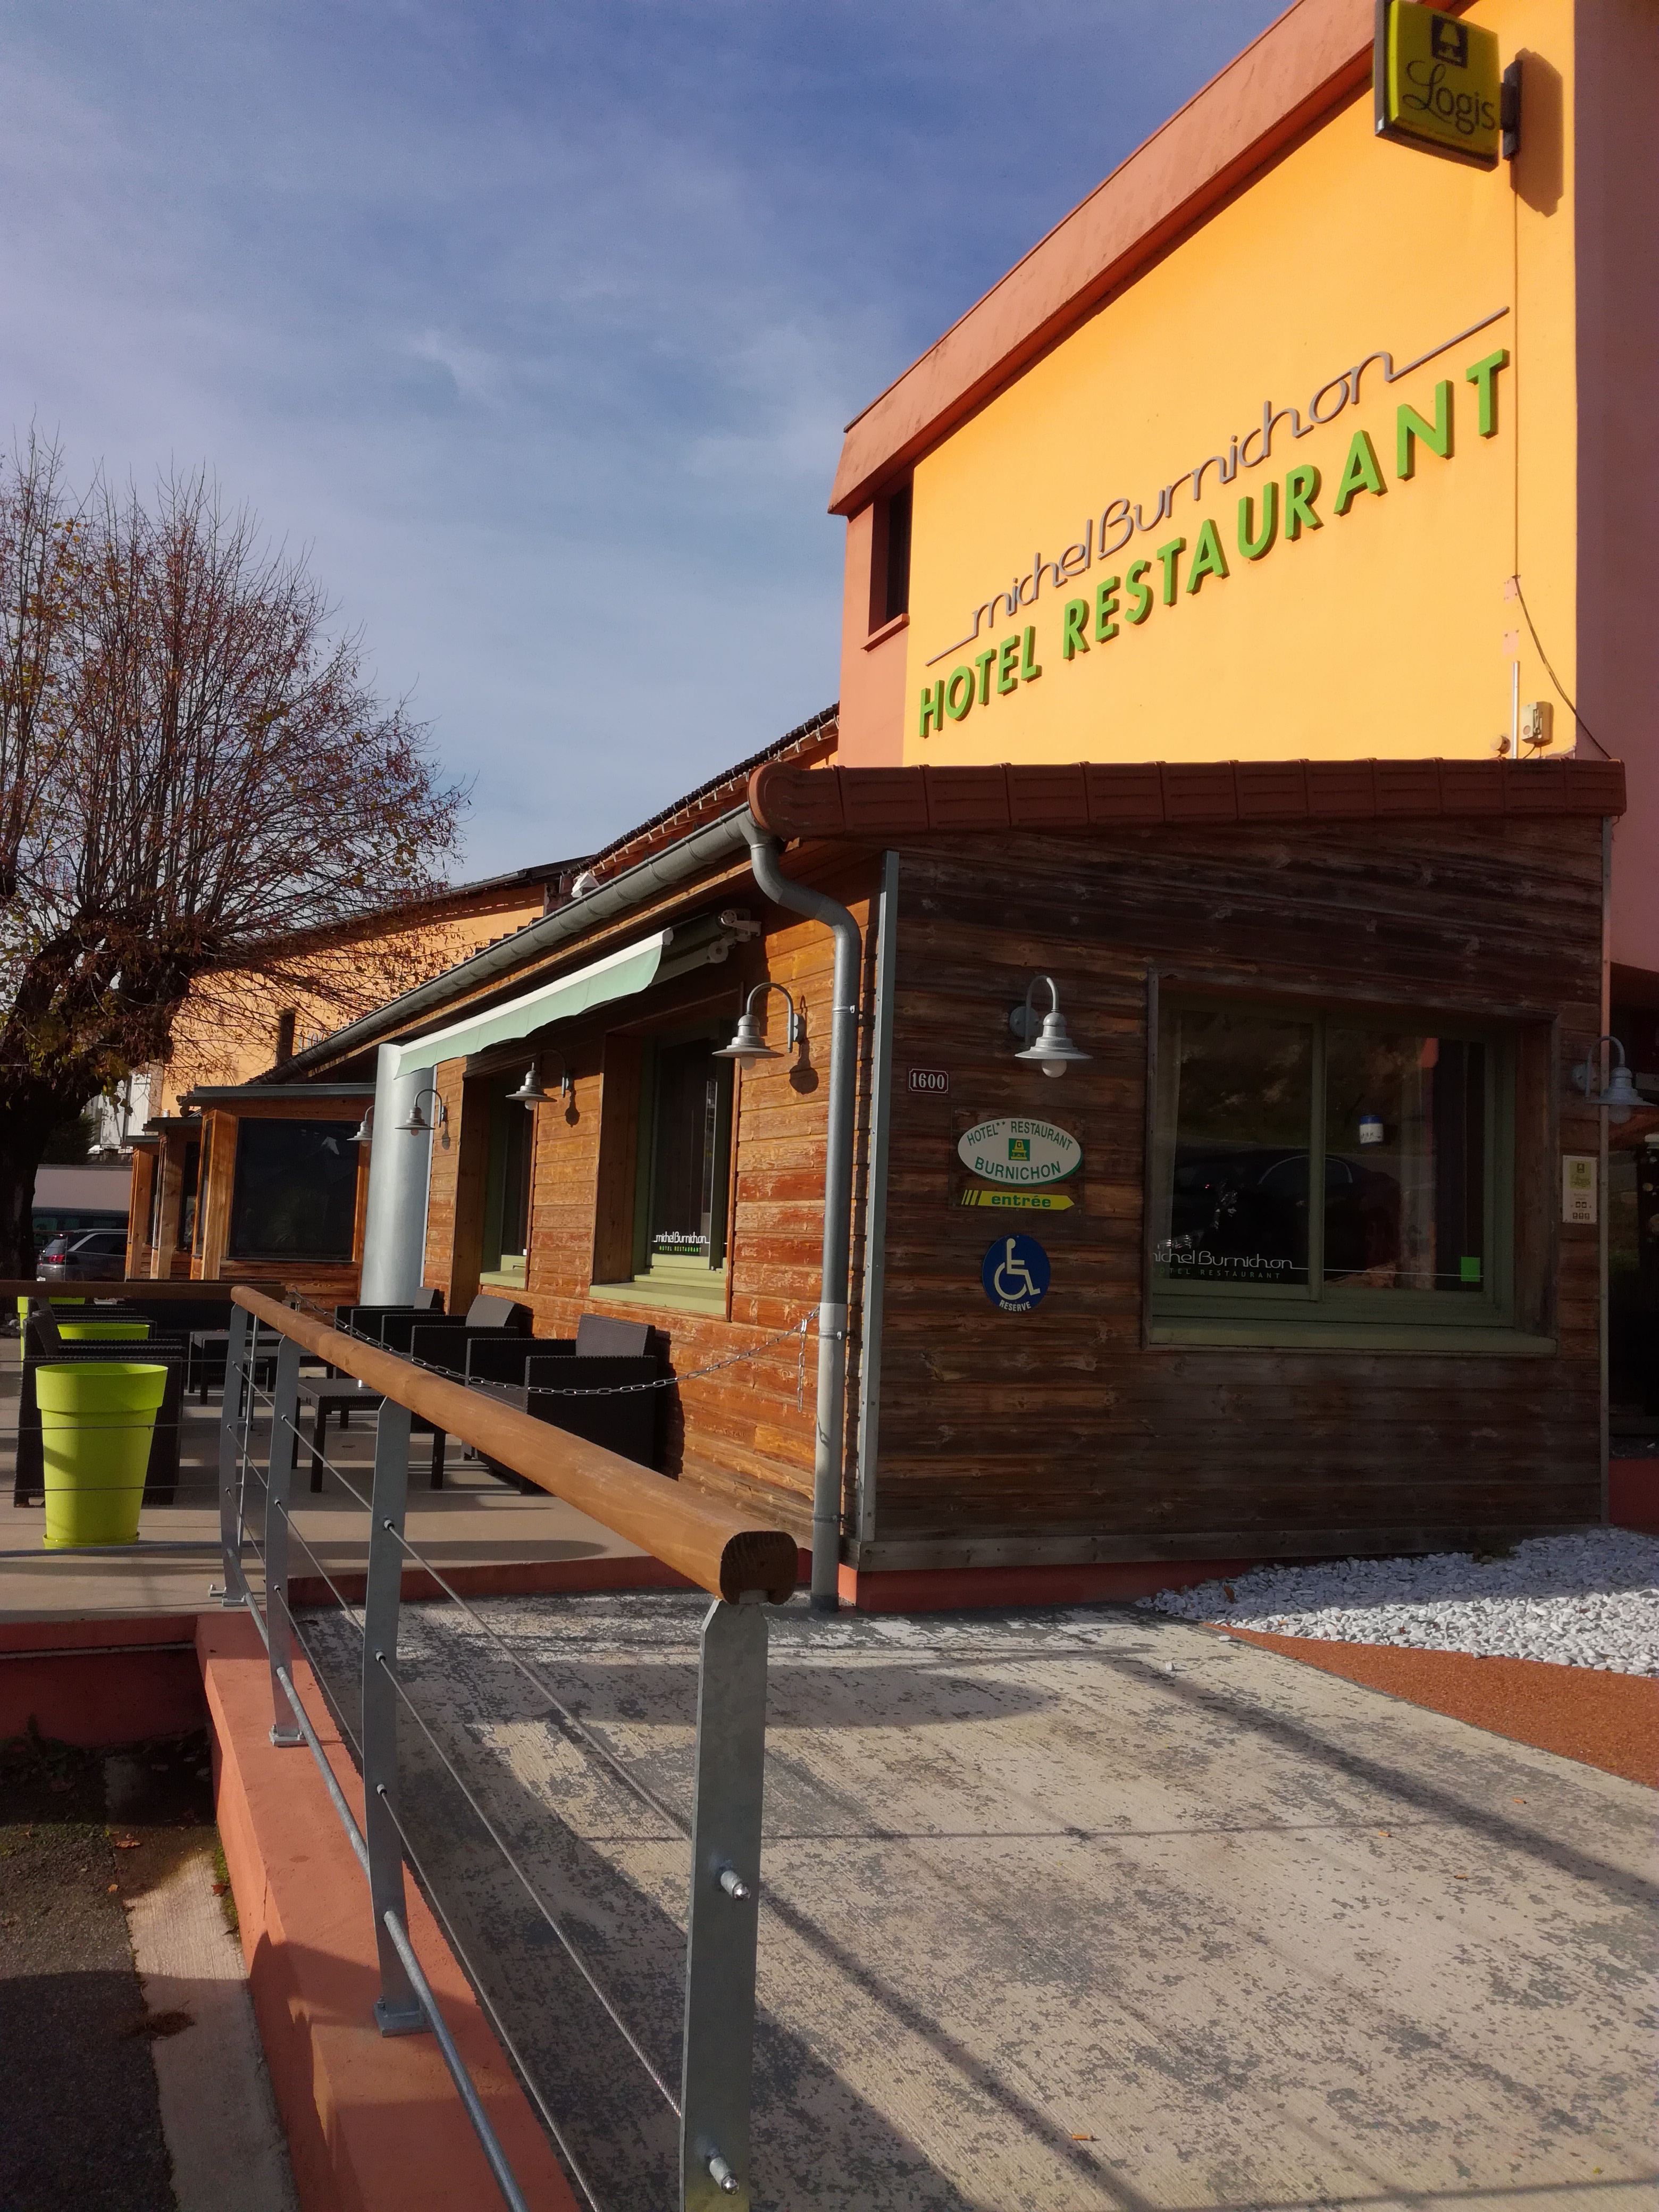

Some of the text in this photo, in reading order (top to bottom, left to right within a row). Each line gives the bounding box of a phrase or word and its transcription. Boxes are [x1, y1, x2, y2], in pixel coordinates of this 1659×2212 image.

[1402, 60, 1496, 135] Logis
[919, 348, 1510, 739] HOTEL RESTAURANT
[912, 1073, 945, 1089] 1600
[1011, 1121, 1073, 1151] RESTAURANT
[975, 1156, 1061, 1180] BURNICHON
[992, 1195, 1051, 1208] entrée
[1200, 1269, 1280, 1279] RESTAURANT
[999, 1299, 1032, 1312] RESERVE
